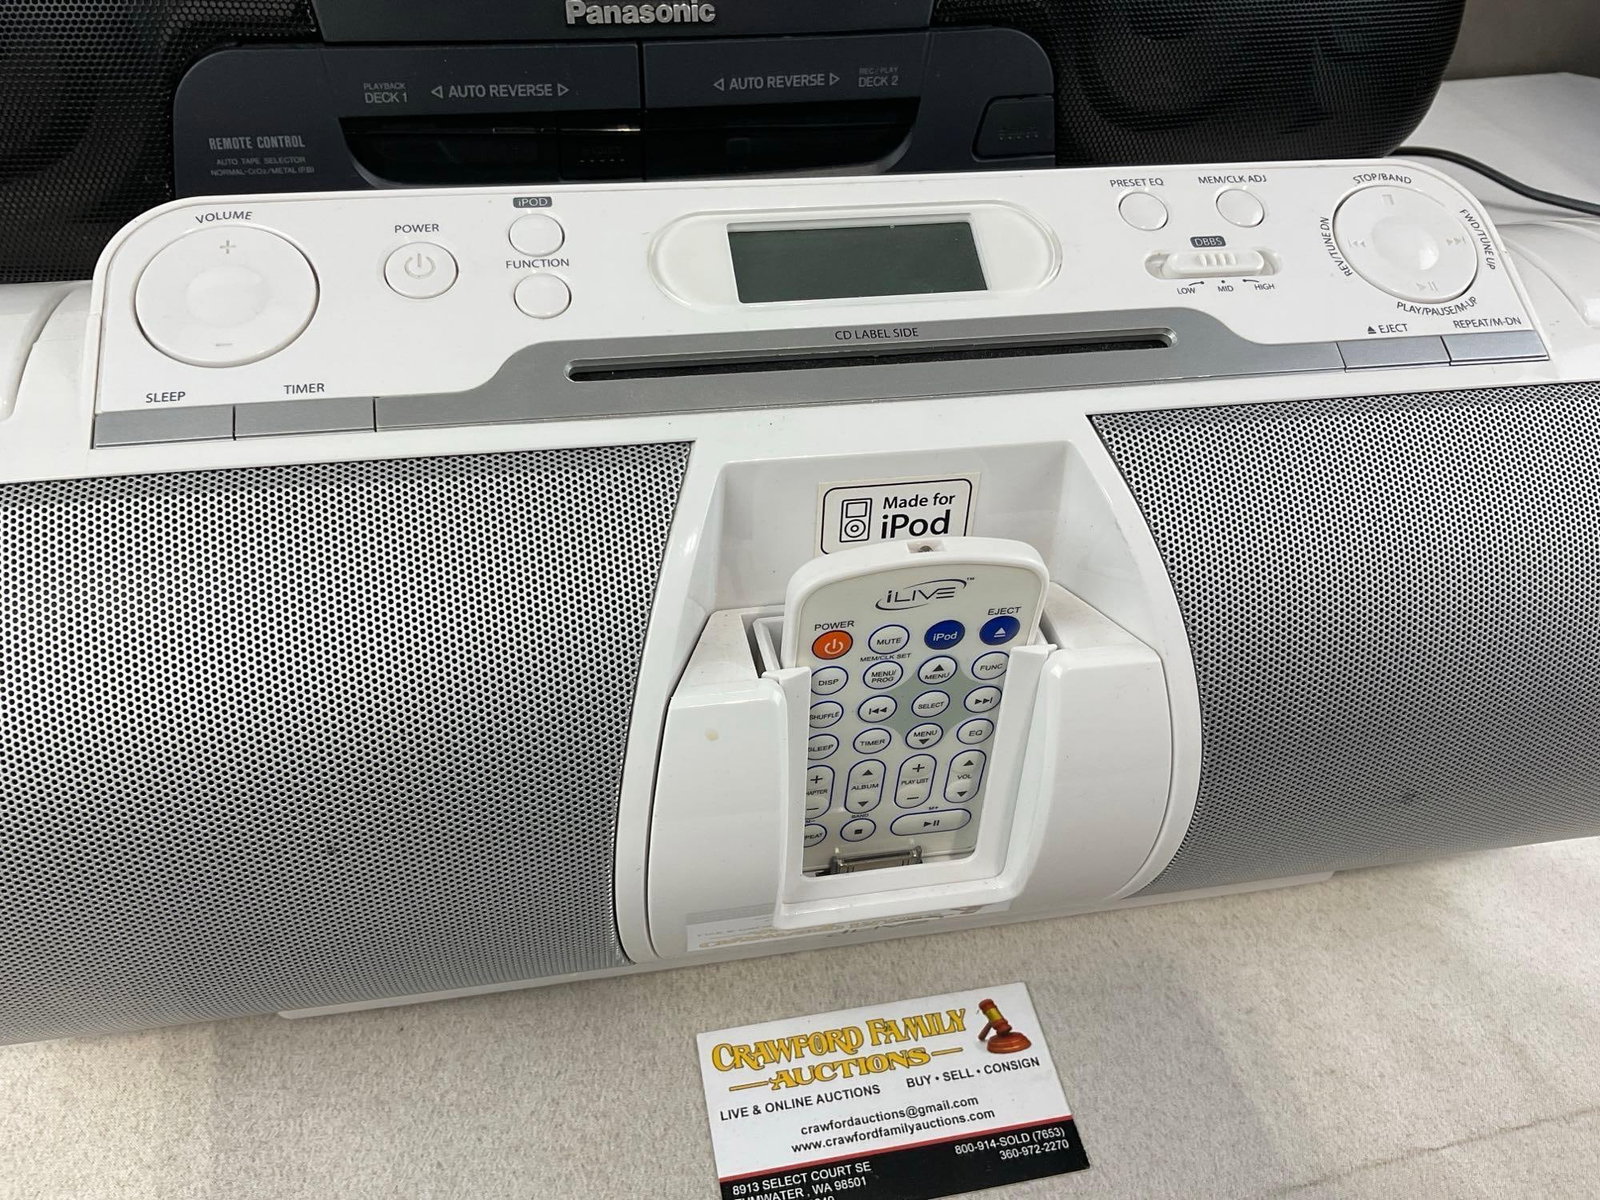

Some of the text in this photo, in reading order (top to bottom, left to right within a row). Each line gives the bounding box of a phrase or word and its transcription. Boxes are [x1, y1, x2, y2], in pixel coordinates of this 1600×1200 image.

[565, 0, 717, 25] Panasonic
[363, 82, 406, 92] PLAYBACK
[729, 73, 826, 90] AUTO REVERSE
[858, 75, 899, 88] DECK 2
[448, 82, 553, 99] AUTO REVERSE
[364, 91, 409, 104] DECK 1
[208, 135, 306, 150] REMOTE CONTROL
[216, 156, 306, 166] AUTO TAPE SELECTOR
[1110, 178, 1164, 187] PRESET EQ
[1198, 174, 1268, 186] MEM/CLK ADJ
[1353, 172, 1412, 185] STOP/BAND
[517, 196, 548, 207] iPOD
[195, 210, 252, 223] VOLUME
[394, 222, 440, 235] POWER
[1459, 208, 1495, 256] FWD/TUNE
[1194, 235, 1223, 248] DBBS
[1321, 231, 1353, 278] REV/TUNE
[505, 258, 569, 270] FUNCTION
[1177, 282, 1276, 296] LOW MID HIGH
[1396, 295, 1479, 317] PLAY/PAUSE/M-UP
[1378, 323, 1409, 335] EJECT
[1452, 316, 1523, 330] REPEAT/M-DN
[835, 327, 920, 341] CD LABEL SIDE
[283, 381, 326, 395] TIMER
[145, 390, 187, 404] SLEEP
[882, 492, 956, 510] Made for
[880, 509, 951, 539] iPod
[885, 586, 957, 604] iLIVE
[987, 606, 1022, 616] EJECT
[814, 620, 855, 632] POWER
[876, 635, 903, 646] MUTE
[932, 629, 958, 642] iPod
[859, 652, 912, 663] MEM/CLK SET
[979, 662, 1004, 672] FUNC
[870, 670, 898, 678] MENU/
[870, 676, 895, 684] PROG
[924, 672, 950, 681] MENU
[817, 678, 840, 687] DISP
[917, 701, 945, 711] SELECT
[809, 711, 841, 721] SHUFFLE
[912, 729, 939, 738] MENU
[968, 730, 984, 738] EQ
[859, 738, 886, 748] TIMER
[957, 773, 973, 781] VOL
[851, 783, 880, 792] ALBUM
[711, 1008, 967, 1073] CRAWFORD FAMILY
[768, 1046, 932, 1091] AUCTIONS
[906, 1056, 1040, 1088] BUY SELL CONSIGN
[719, 1083, 881, 1121] LIVE & ONLINE AUCTIONS
[800, 1094, 980, 1136] crawfordauctions@gmail.com
[791, 1107, 996, 1154] www.crawfordfamilyauctions.com
[954, 1126, 1066, 1155] 800-914-SOLD (7653)
[999, 1138, 1070, 1160] 360-972-2270
[732, 1160, 872, 1196] 8913 SELECT COURT SE
[811, 1182, 834, 1195] WA
[833, 1175, 867, 1191] 98501
